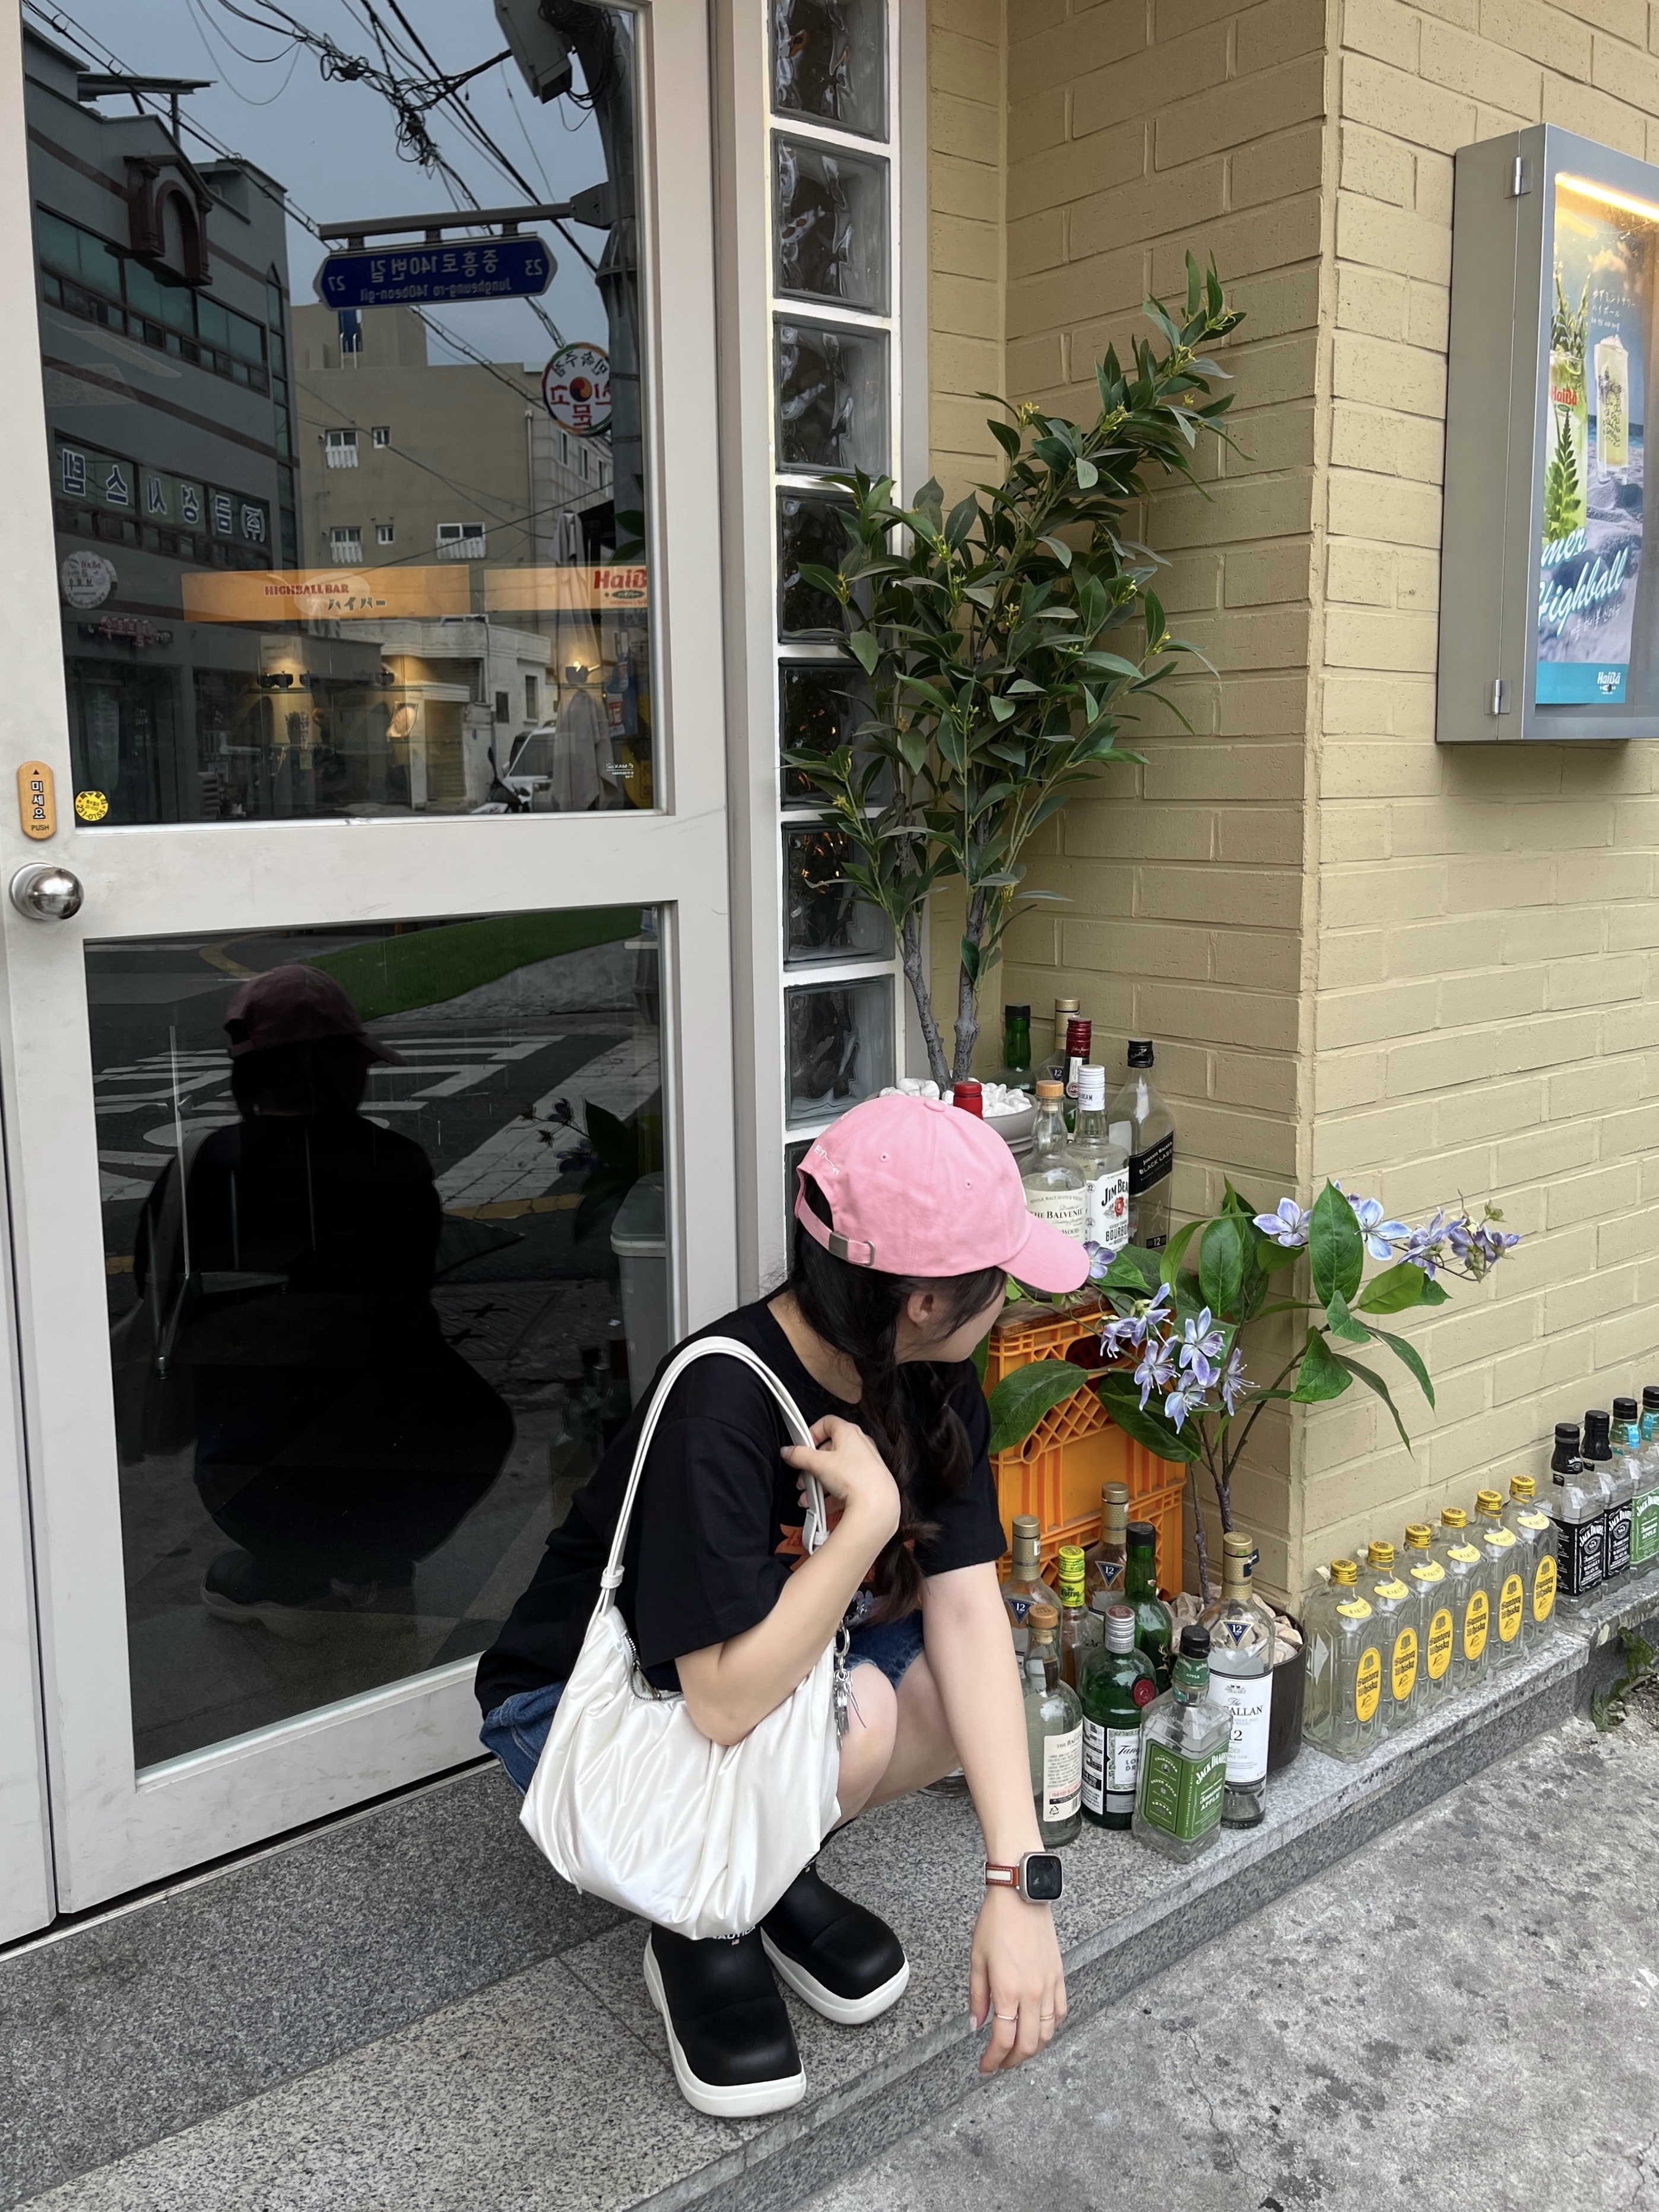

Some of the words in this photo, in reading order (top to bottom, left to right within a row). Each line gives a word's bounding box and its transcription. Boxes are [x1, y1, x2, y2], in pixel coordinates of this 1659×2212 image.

[265, 584, 324, 595] HIGHBALL
[325, 584, 350, 594] BAR
[328, 596, 386, 611] ハイバー
[30, 781, 46, 819] 미세요
[77, 804, 106, 820] 231-0155
[1138, 1159, 1159, 1175] BLACK
[1101, 1184, 1117, 1208] JIM
[1153, 1237, 1162, 1247] 12
[1608, 1514, 1620, 1531] JACK
[1579, 1529, 1591, 1547] JACK
[1105, 1565, 1114, 1574] 12
[1535, 1576, 1554, 1590] Suntory
[1536, 1585, 1553, 1599] Whisky
[1016, 1602, 1026, 1612] 12
[1501, 1596, 1521, 1610] Suntory
[1466, 1612, 1487, 1628] Suntory
[1501, 1605, 1520, 1620] Whisky
[1232, 1624, 1242, 1633] 12
[1466, 1622, 1486, 1637] Whisky
[1429, 1630, 1451, 1646] Suntory
[1429, 1640, 1449, 1656] Whisky
[1394, 1650, 1416, 1666] Suntory
[1394, 1660, 1415, 1676] Whisky
[1357, 1670, 1379, 1688] Suntory
[1357, 1680, 1378, 1697] Whisky
[1227, 1697, 1242, 1707] The
[1229, 1729, 1243, 1742] 12
[1196, 1761, 1211, 1785] JACK
[1165, 1783, 1177, 1797] APPLE
[1152, 1801, 1172, 1815] SMOOTH
[1200, 1792, 1220, 1811] APPLE
